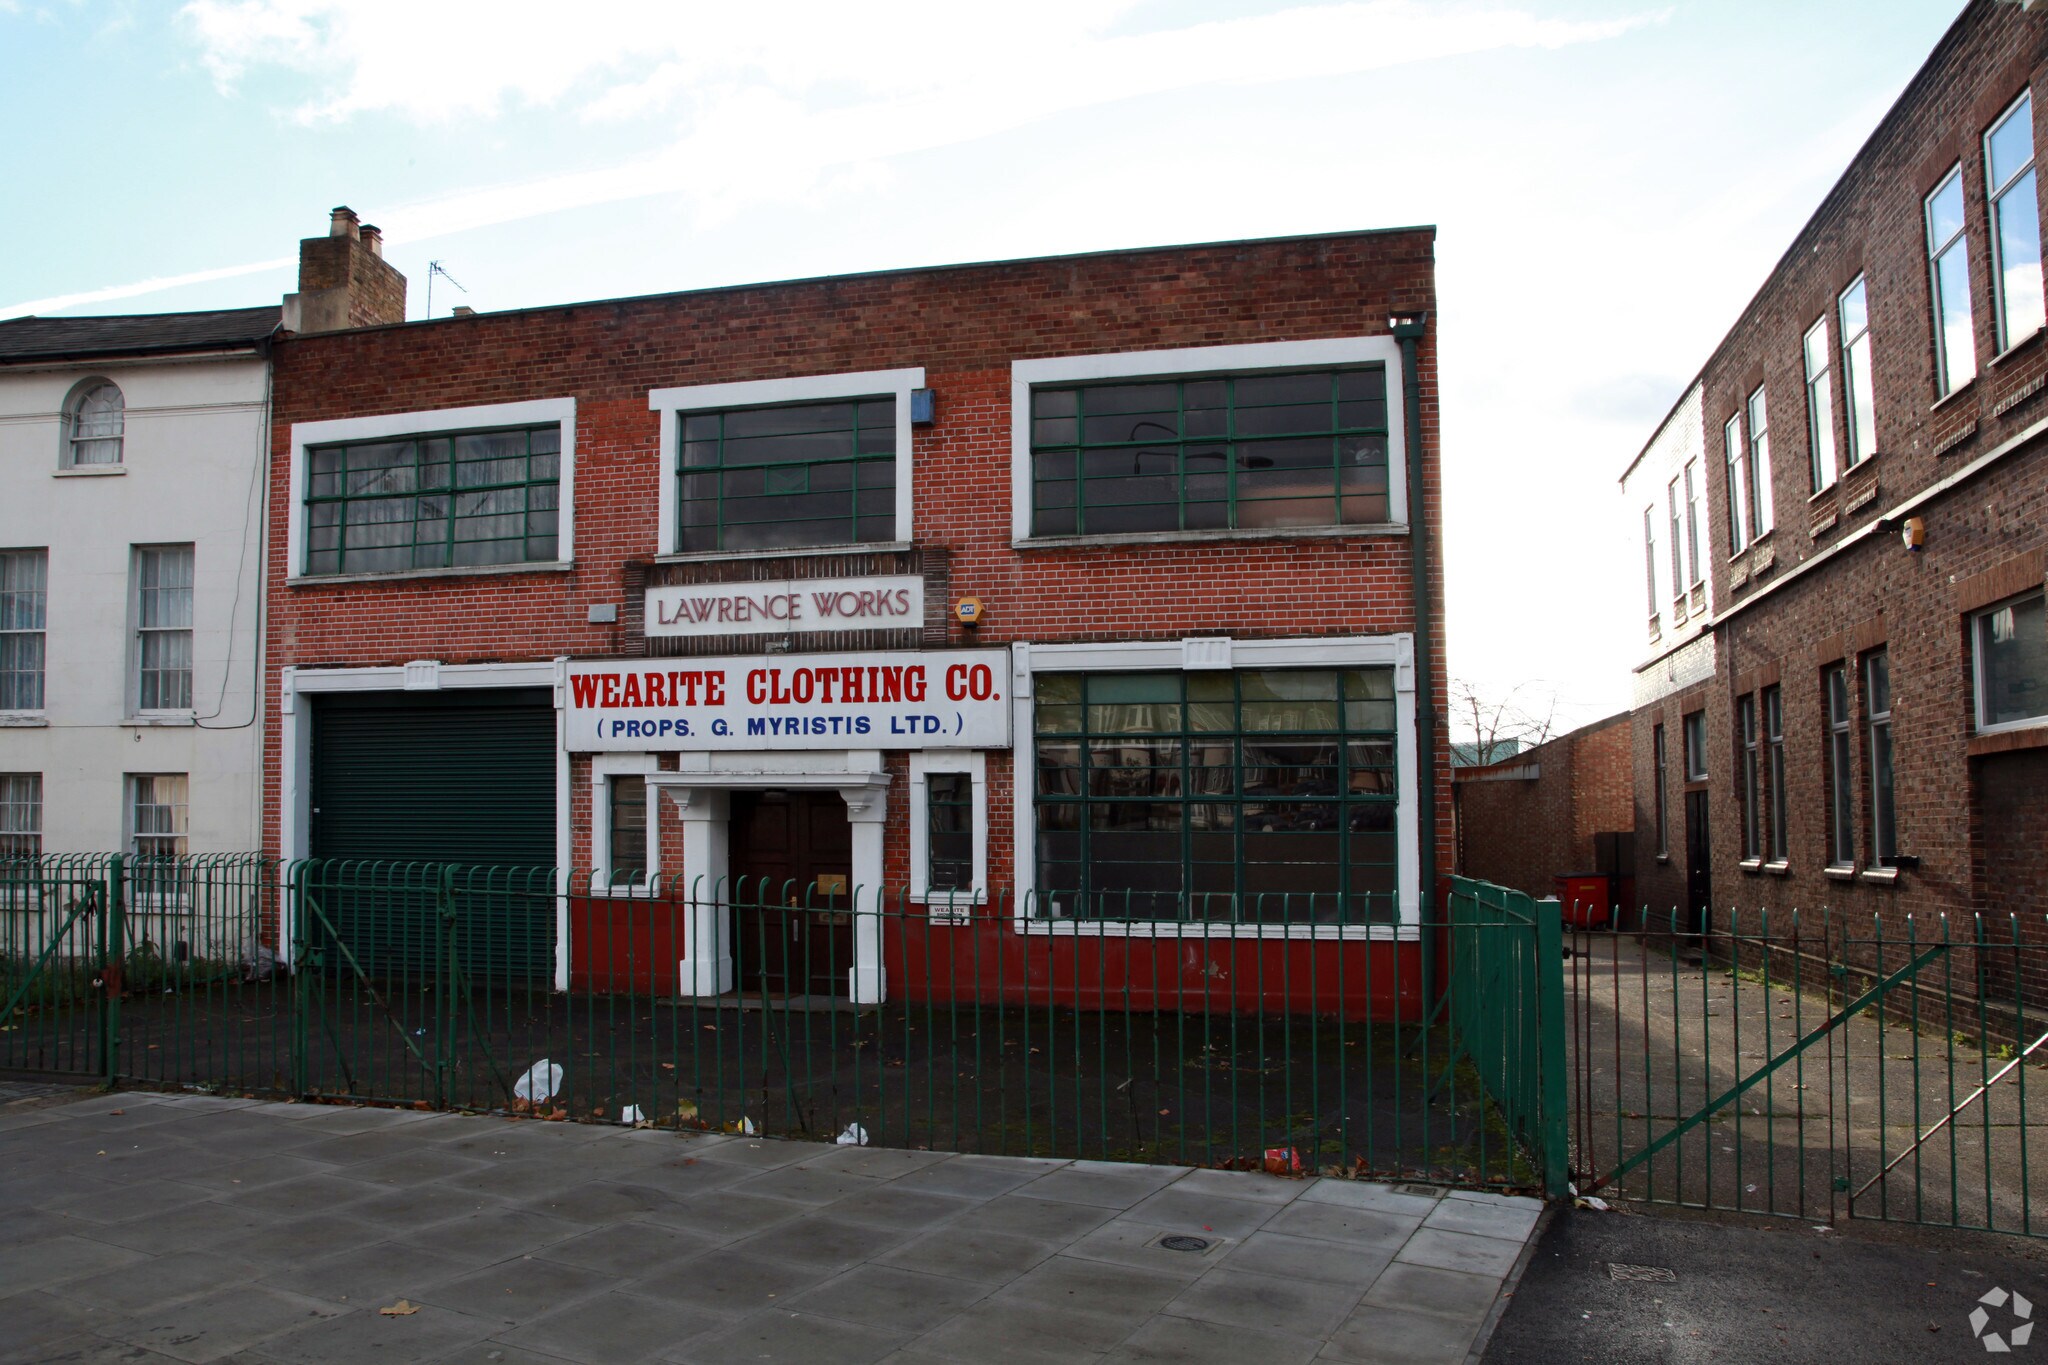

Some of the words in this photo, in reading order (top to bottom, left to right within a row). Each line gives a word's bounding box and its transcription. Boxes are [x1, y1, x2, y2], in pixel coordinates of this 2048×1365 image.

[657, 593, 802, 625] LAWRENCE
[811, 588, 910, 618] WORKS
[961, 604, 975, 614] ADT
[570, 670, 726, 709] WEARITE
[746, 665, 928, 705] CLOTHING
[945, 663, 1001, 702] CO.
[710, 718, 734, 737] G.
[747, 715, 872, 736] MYRISTIS
